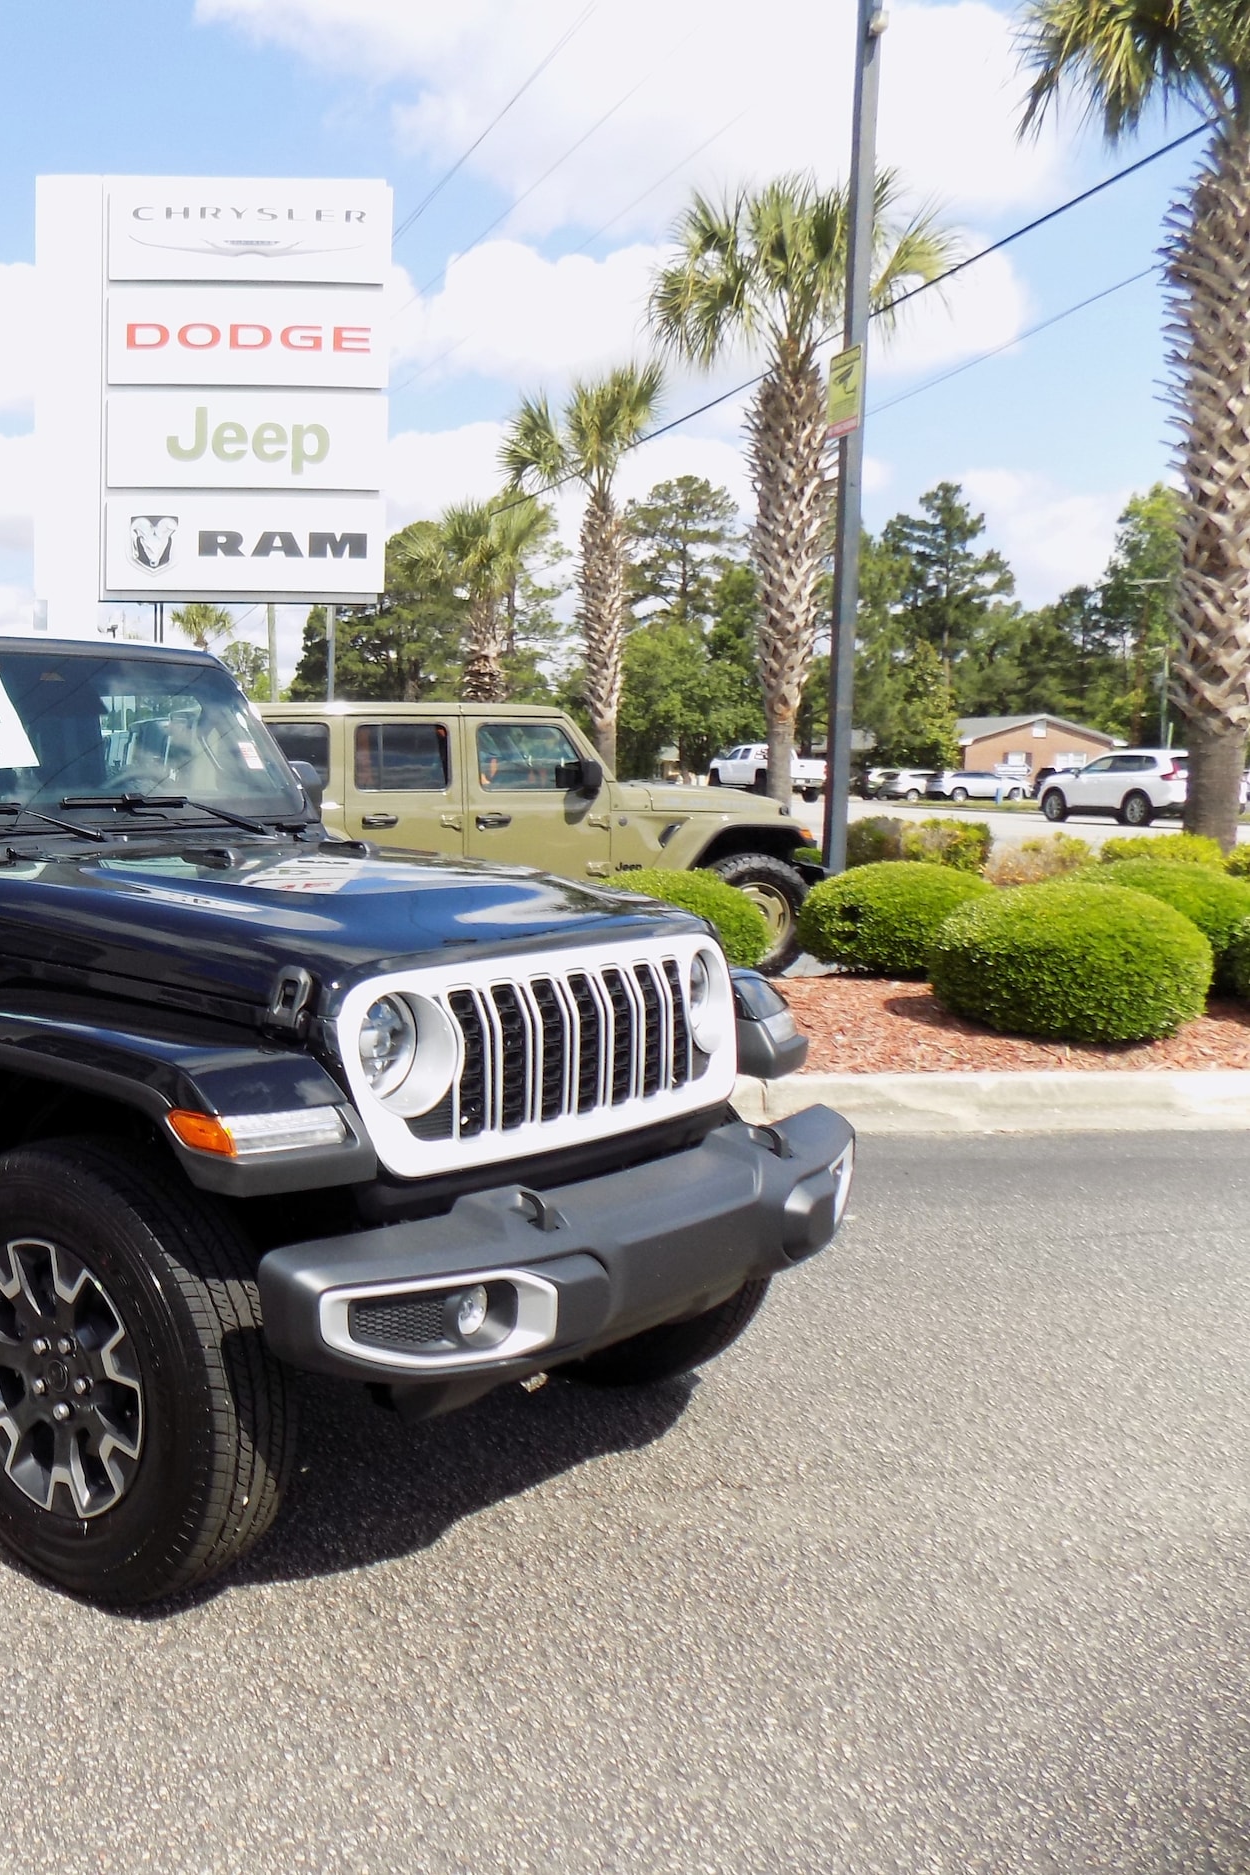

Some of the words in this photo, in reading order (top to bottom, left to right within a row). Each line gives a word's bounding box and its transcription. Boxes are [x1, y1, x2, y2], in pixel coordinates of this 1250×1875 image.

[132, 206, 367, 224] CHRYSLER
[126, 323, 371, 354] DODGE
[166, 406, 330, 475] Jeep
[198, 530, 368, 559] RAM
